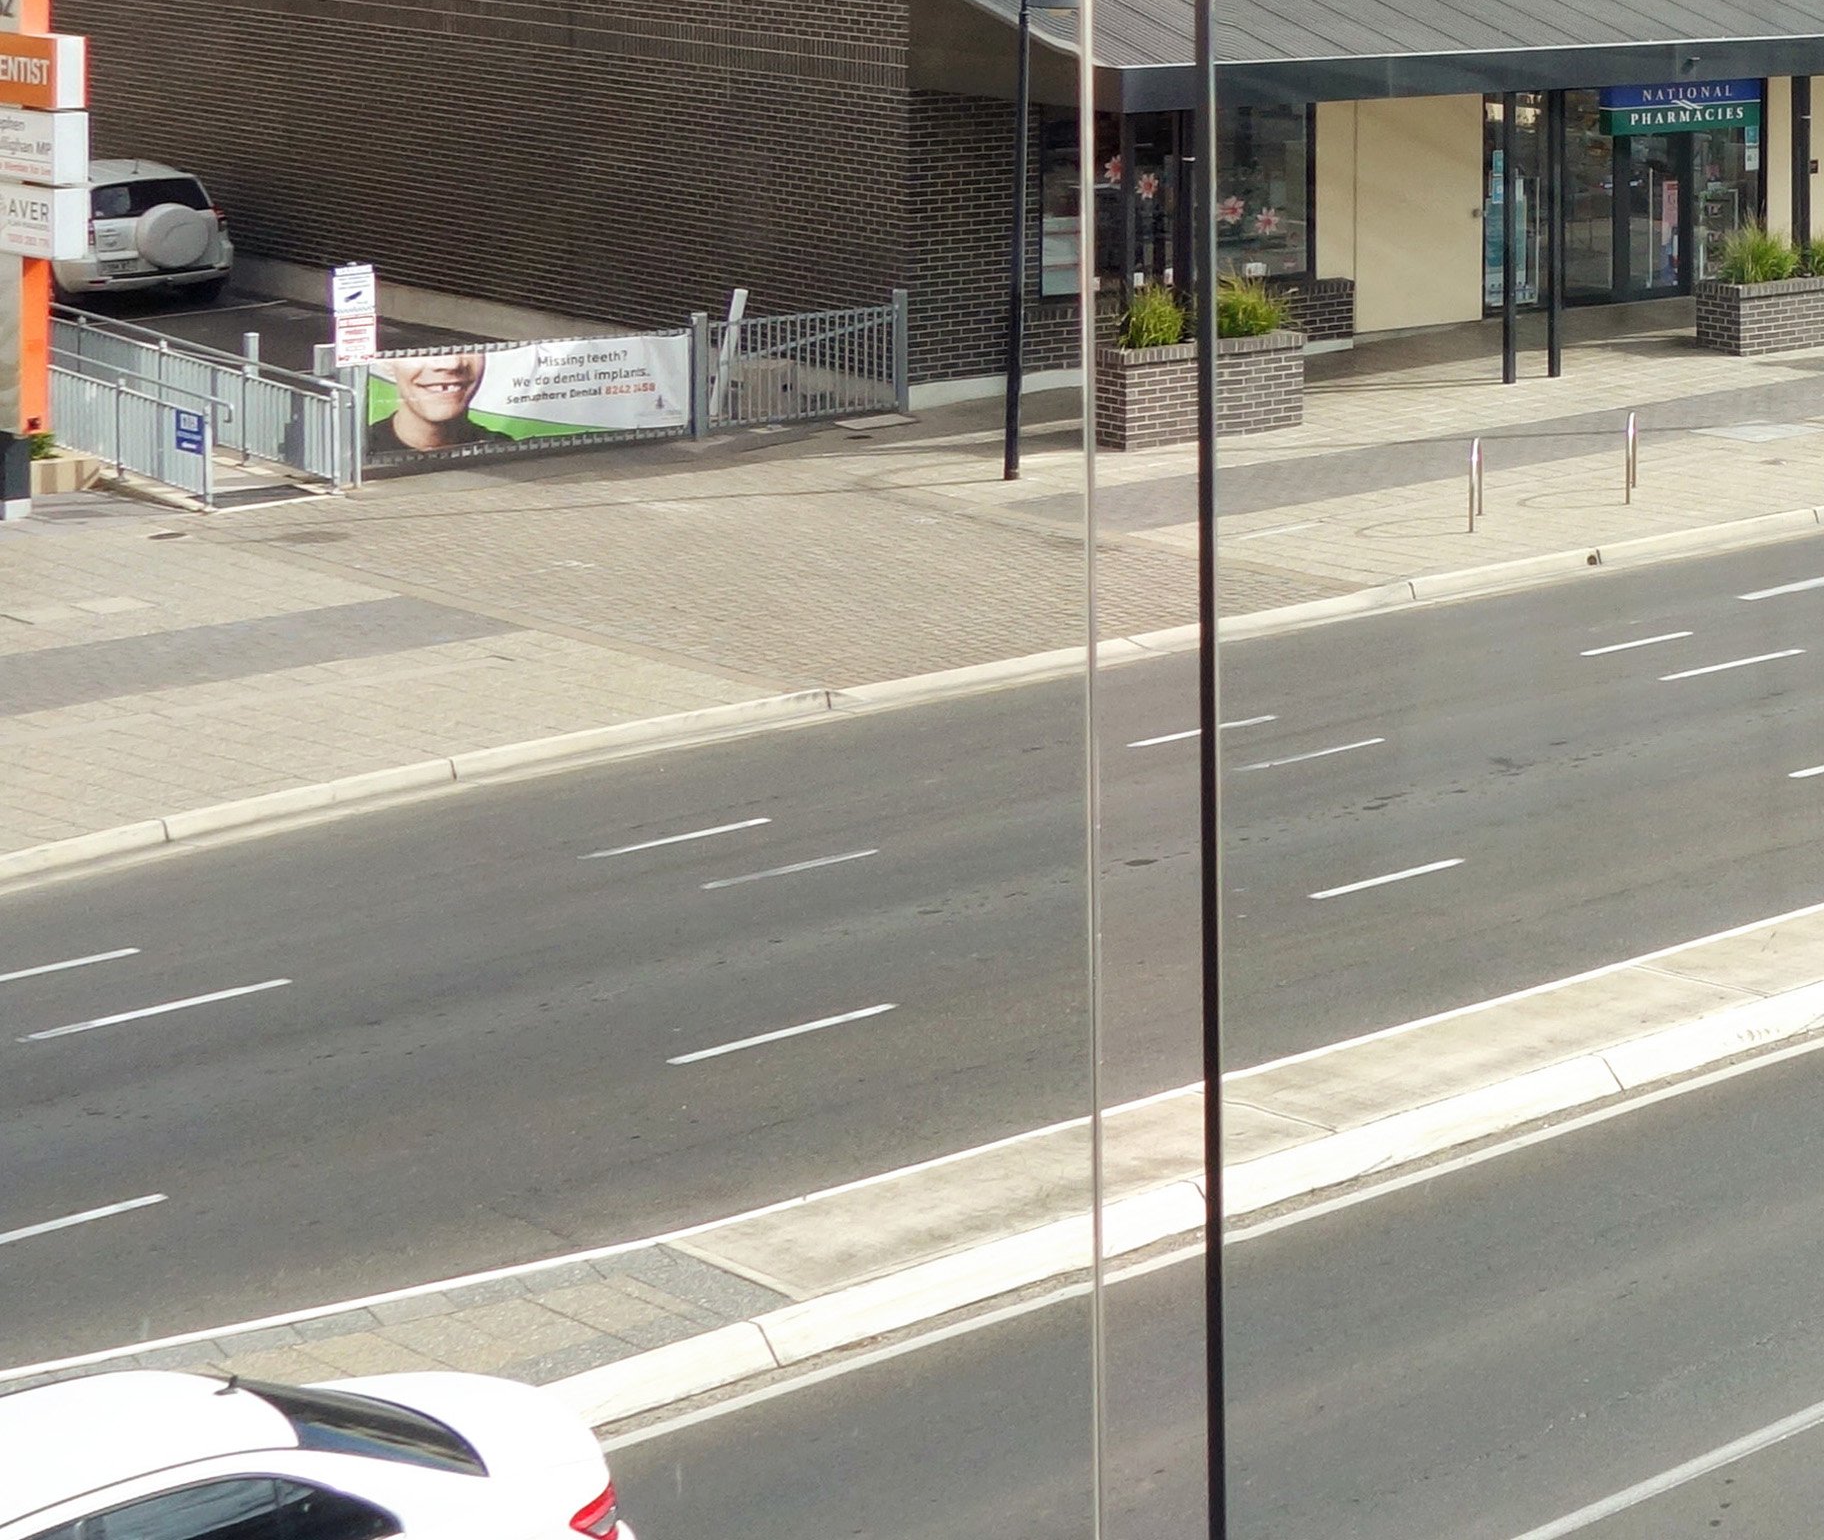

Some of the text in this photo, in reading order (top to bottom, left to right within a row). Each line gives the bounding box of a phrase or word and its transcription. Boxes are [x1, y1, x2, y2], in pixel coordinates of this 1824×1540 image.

[0, 54, 50, 86] ENTIST
[1642, 84, 1733, 102] NATIONAL
[1630, 106, 1744, 126] PHARMACIES
[8, 199, 49, 221] AVER
[537, 350, 628, 368] Missing teeth?
[512, 377, 531, 388] We
[535, 373, 550, 386] do
[553, 371, 591, 385] dental
